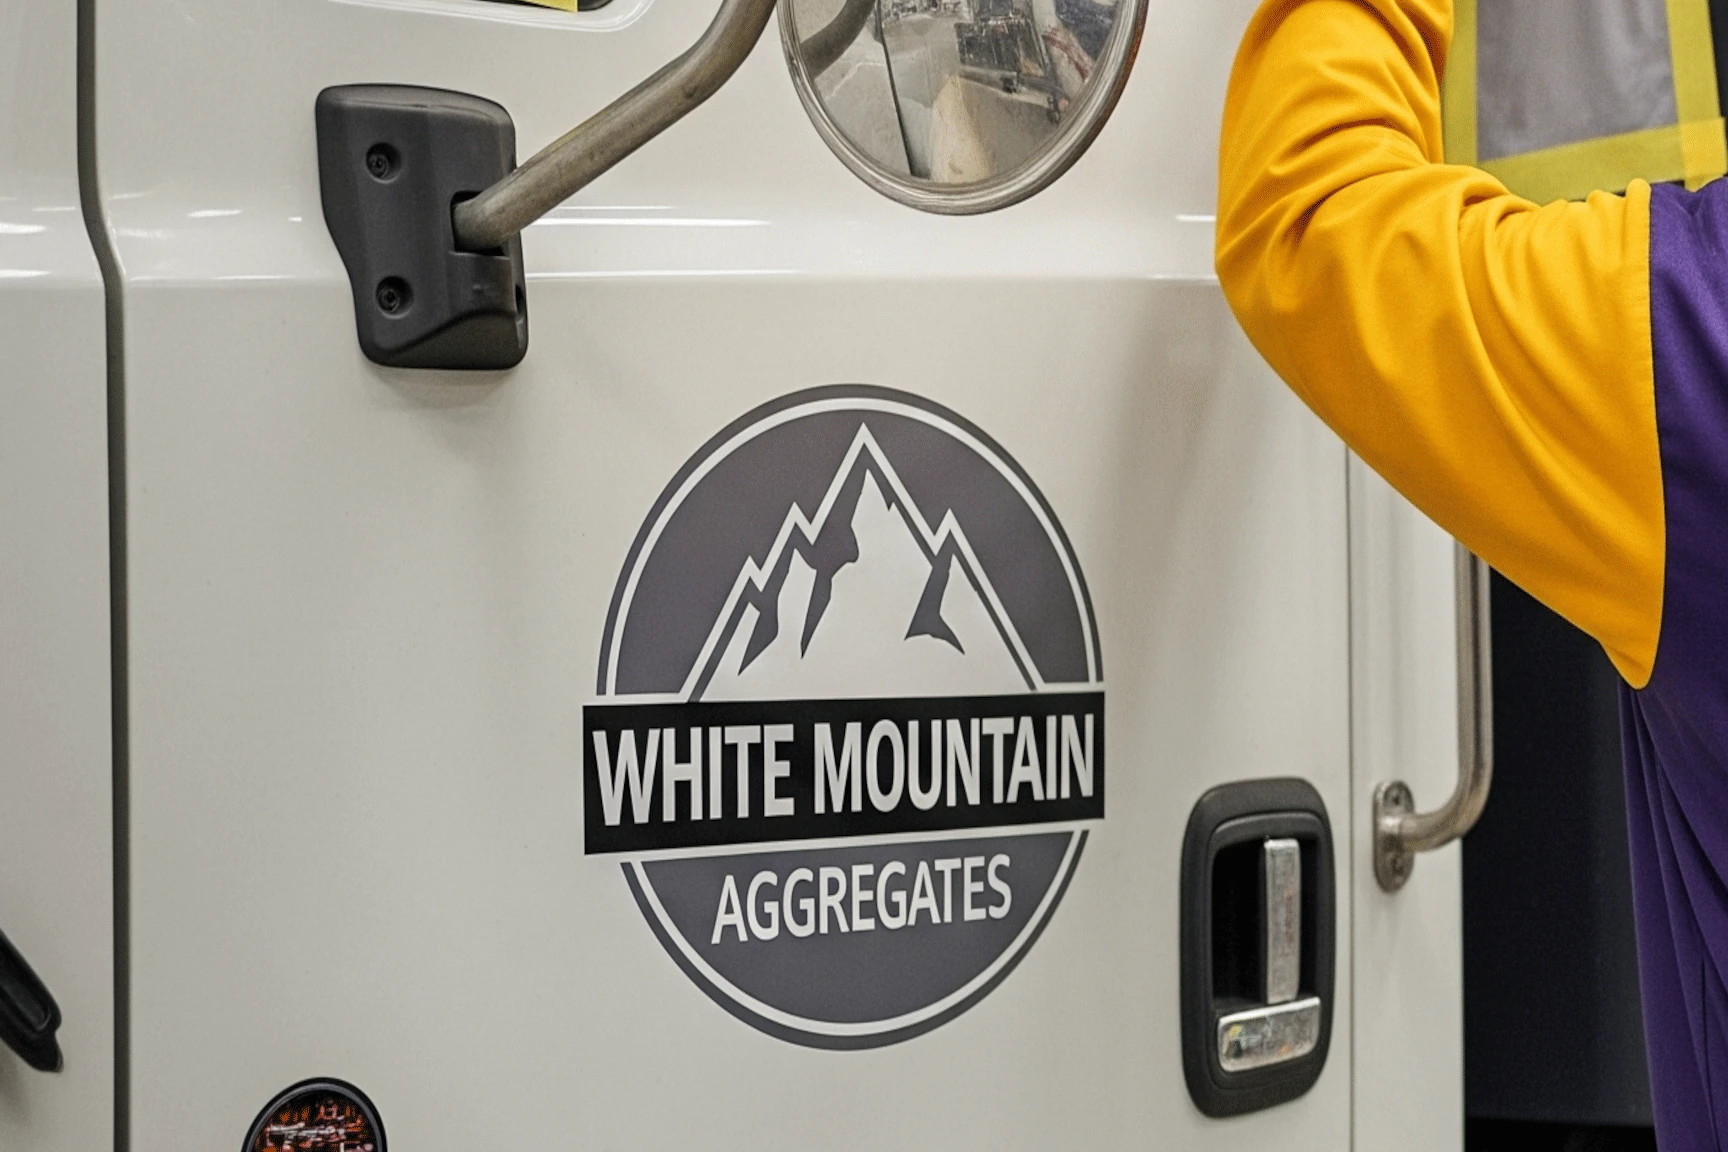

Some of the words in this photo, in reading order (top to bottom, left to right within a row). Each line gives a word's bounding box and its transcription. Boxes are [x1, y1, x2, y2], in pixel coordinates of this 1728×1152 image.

[592, 723, 795, 827] WHITE
[813, 712, 1095, 815] MOUNTAIN
[711, 854, 1013, 945] AGGREGATES
